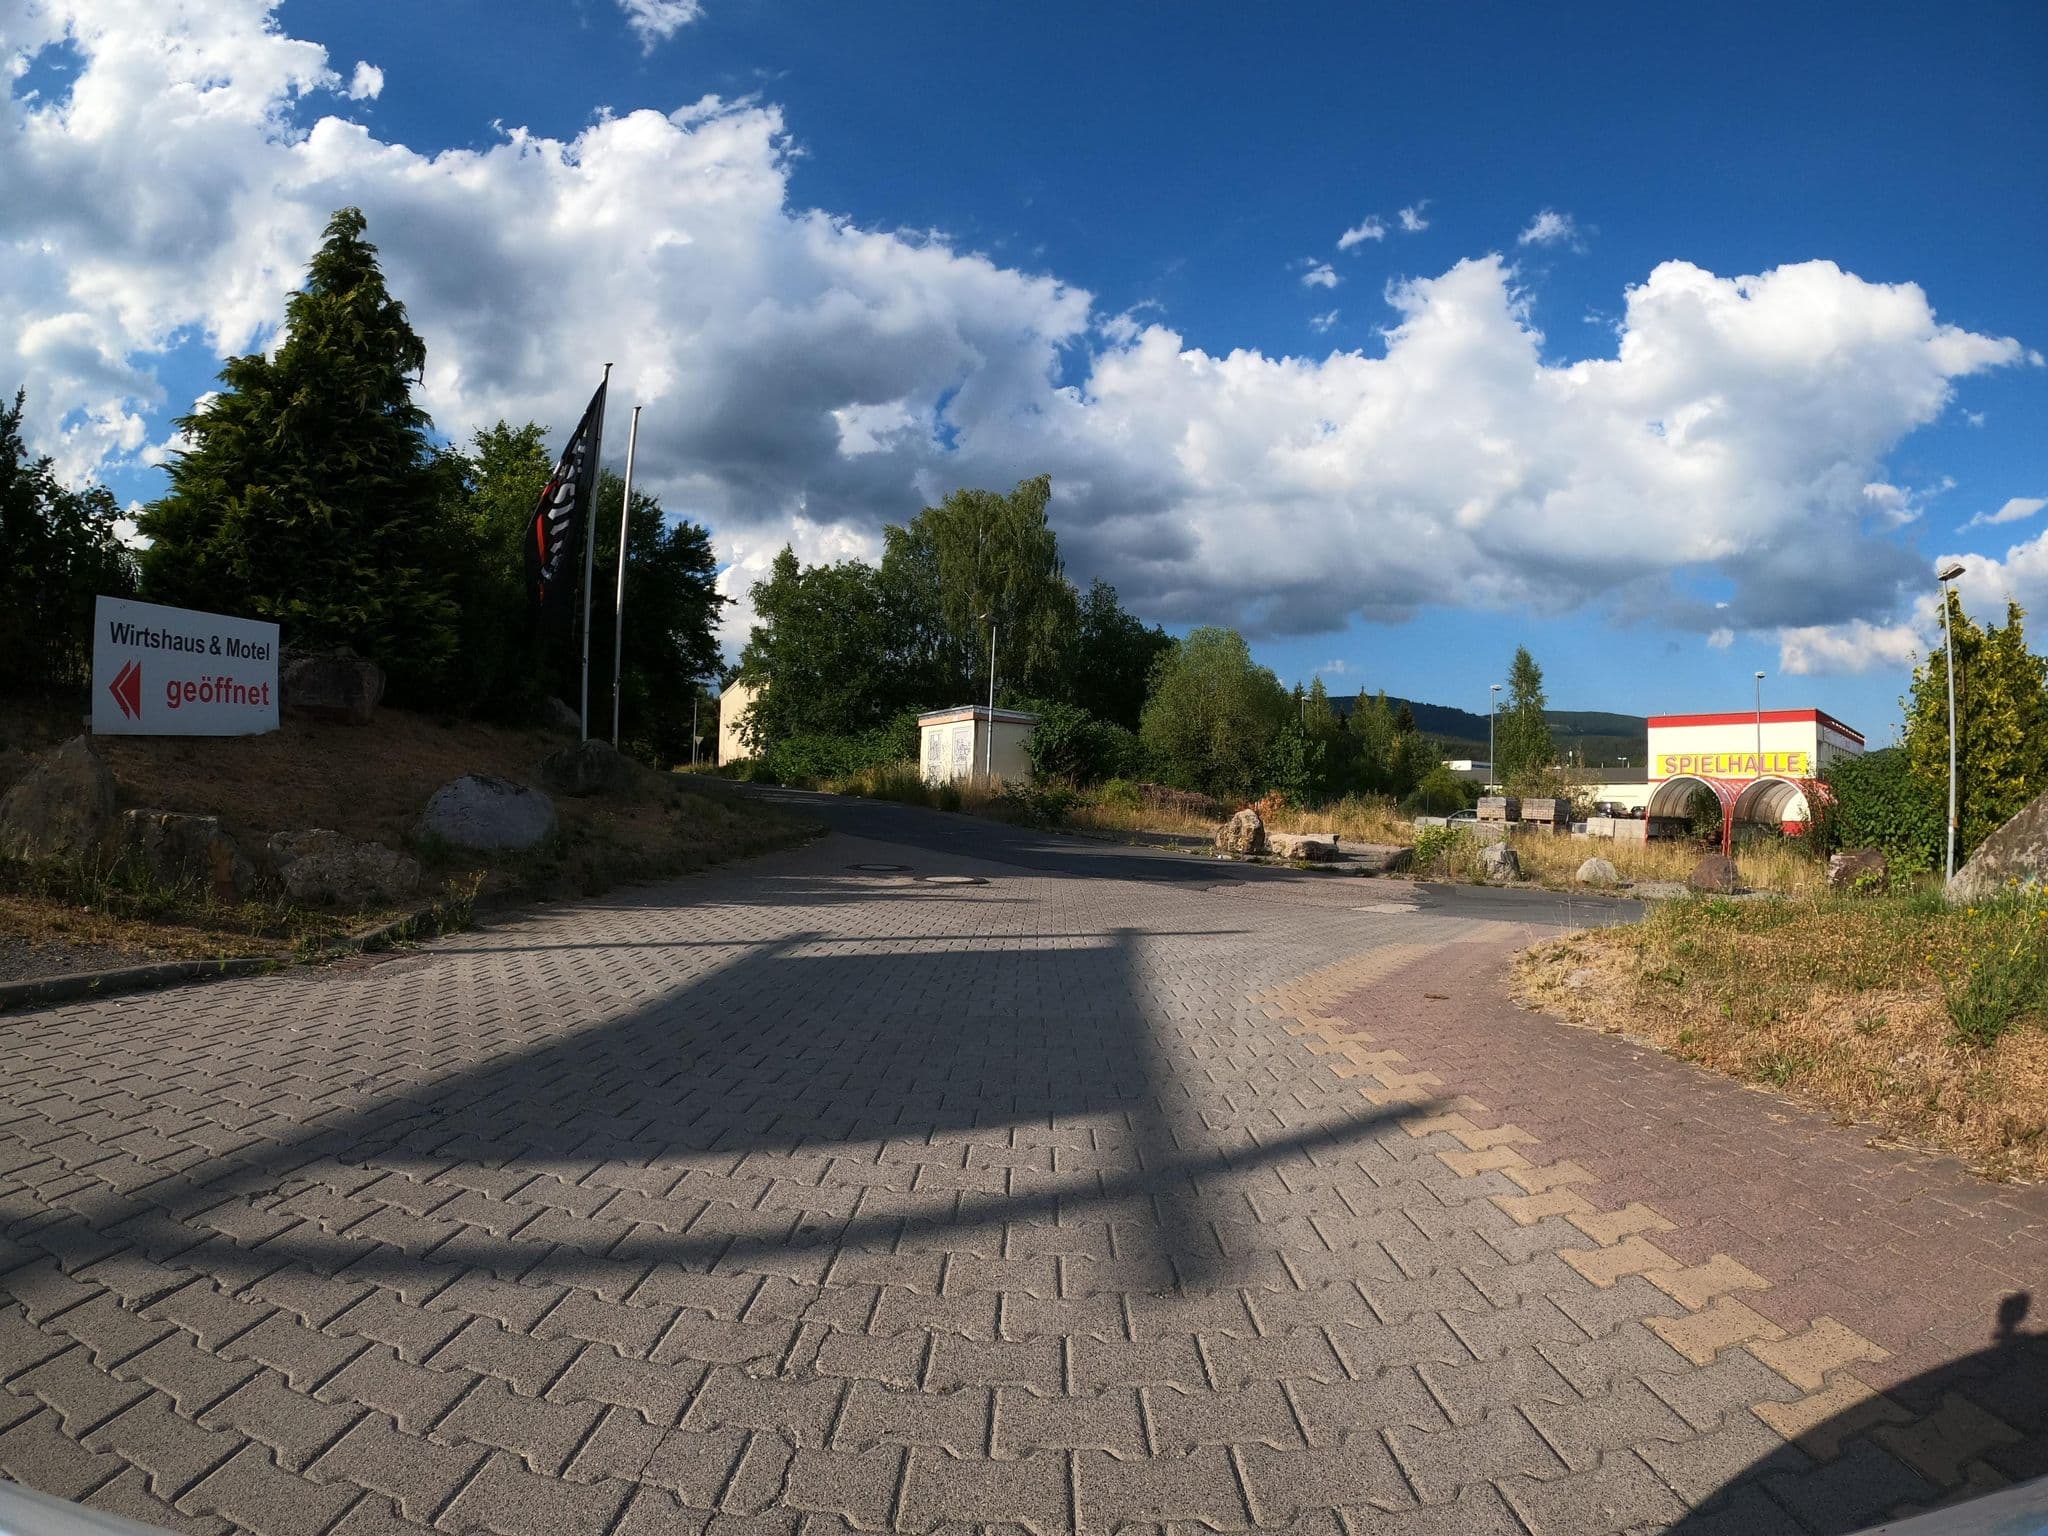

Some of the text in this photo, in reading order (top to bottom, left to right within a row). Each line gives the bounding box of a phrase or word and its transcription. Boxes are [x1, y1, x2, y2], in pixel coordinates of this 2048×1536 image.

[110, 621, 270, 661] Wirtshaus & Motel
[166, 675, 270, 709] geöffnet
[1664, 753, 1801, 774] SPIELHALLE
